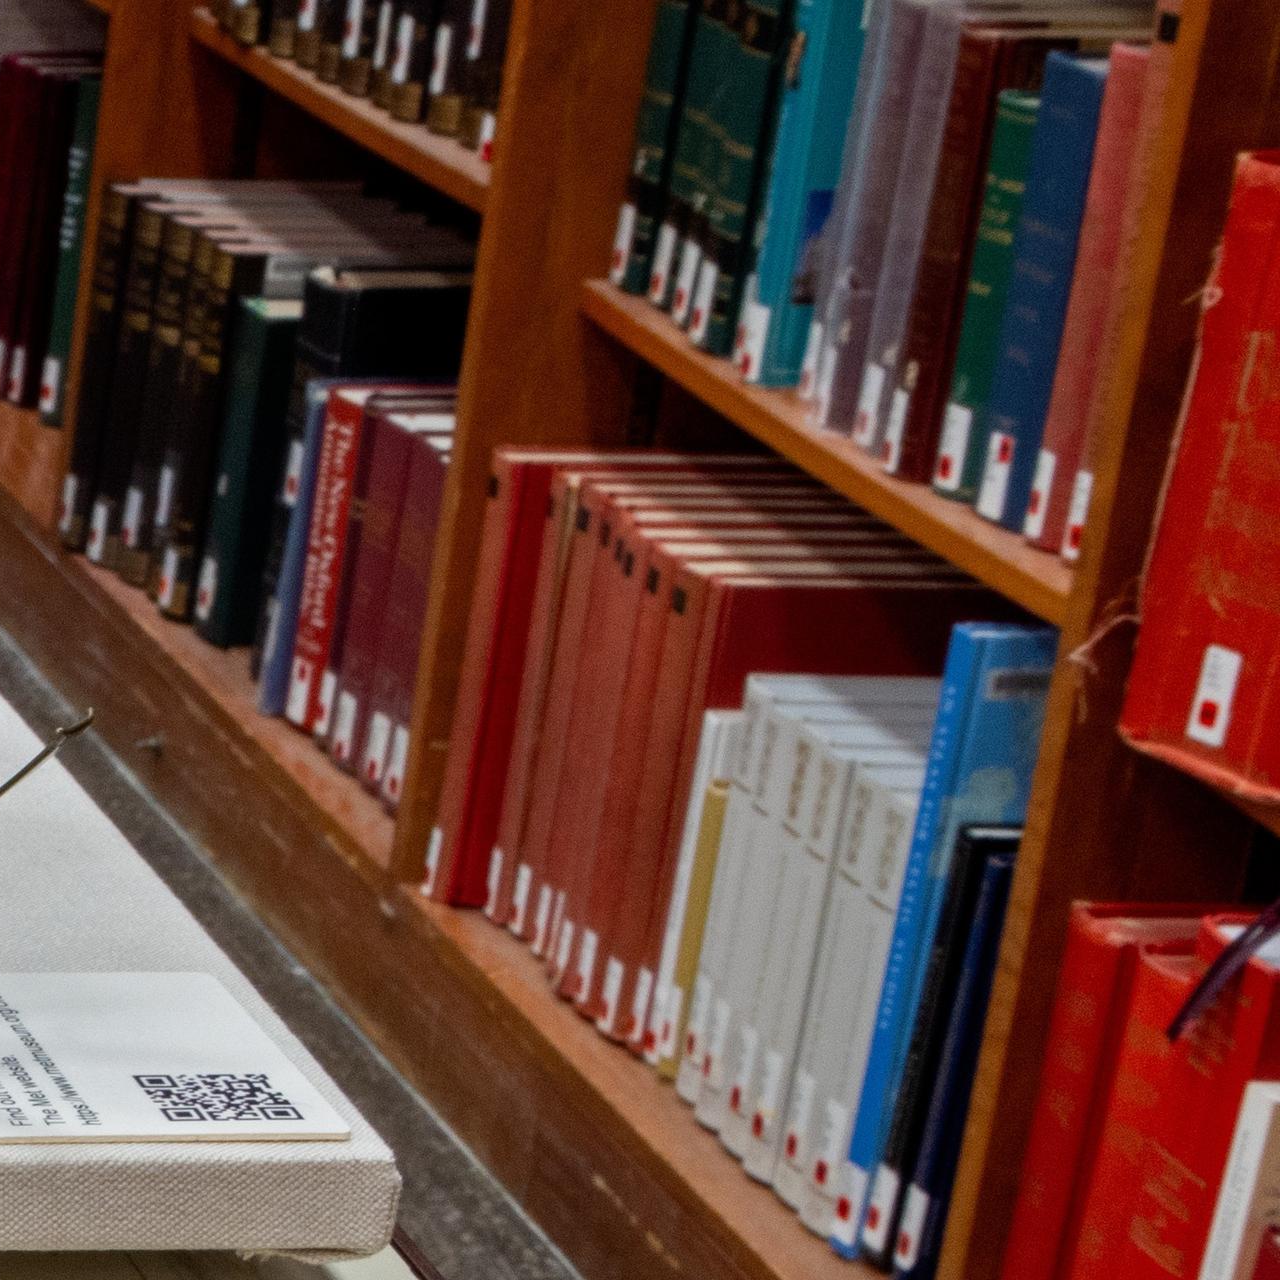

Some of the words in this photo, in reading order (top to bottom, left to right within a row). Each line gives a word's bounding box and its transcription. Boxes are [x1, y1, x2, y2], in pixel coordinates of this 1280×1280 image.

[24, 1090, 52, 1107] Met
[0, 1107, 32, 1127] Find
[42, 1108, 66, 1127] The
